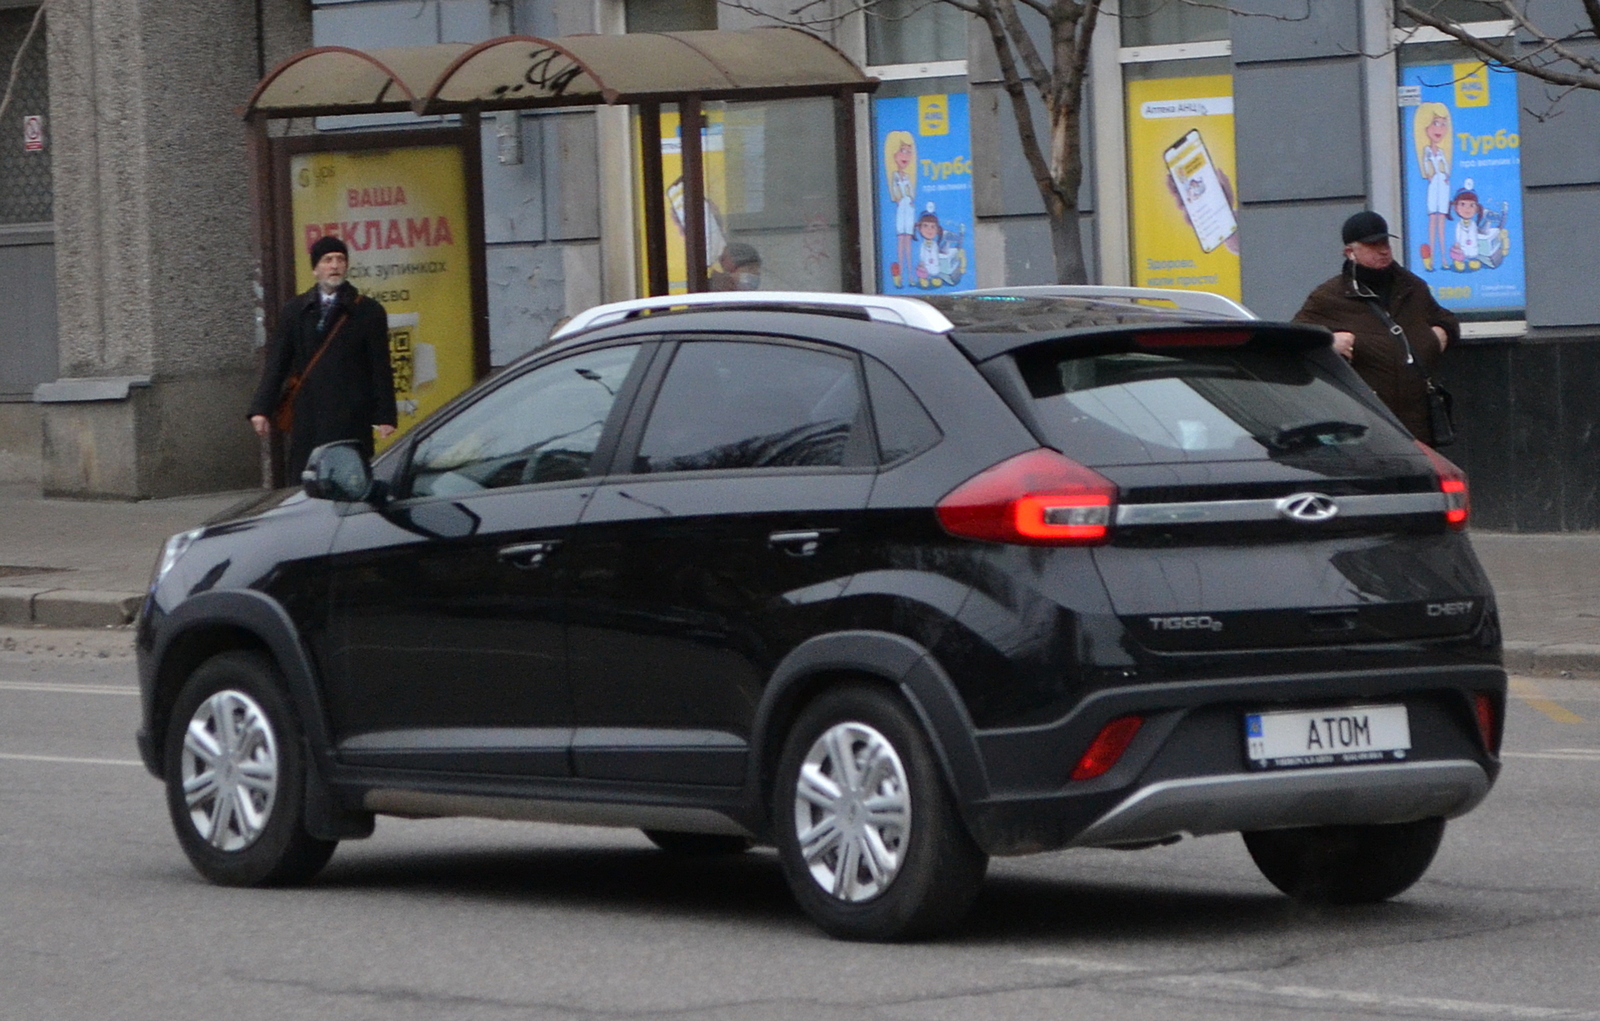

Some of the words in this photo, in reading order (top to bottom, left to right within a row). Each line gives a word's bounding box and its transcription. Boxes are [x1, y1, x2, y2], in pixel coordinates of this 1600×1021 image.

[1457, 129, 1520, 155] Турбо
[347, 186, 407, 208] ВАША
[375, 261, 446, 280] зупинках
[1426, 601, 1474, 617] CHERY
[1307, 715, 1371, 750] ATOM
[1252, 742, 1265, 757] 11
